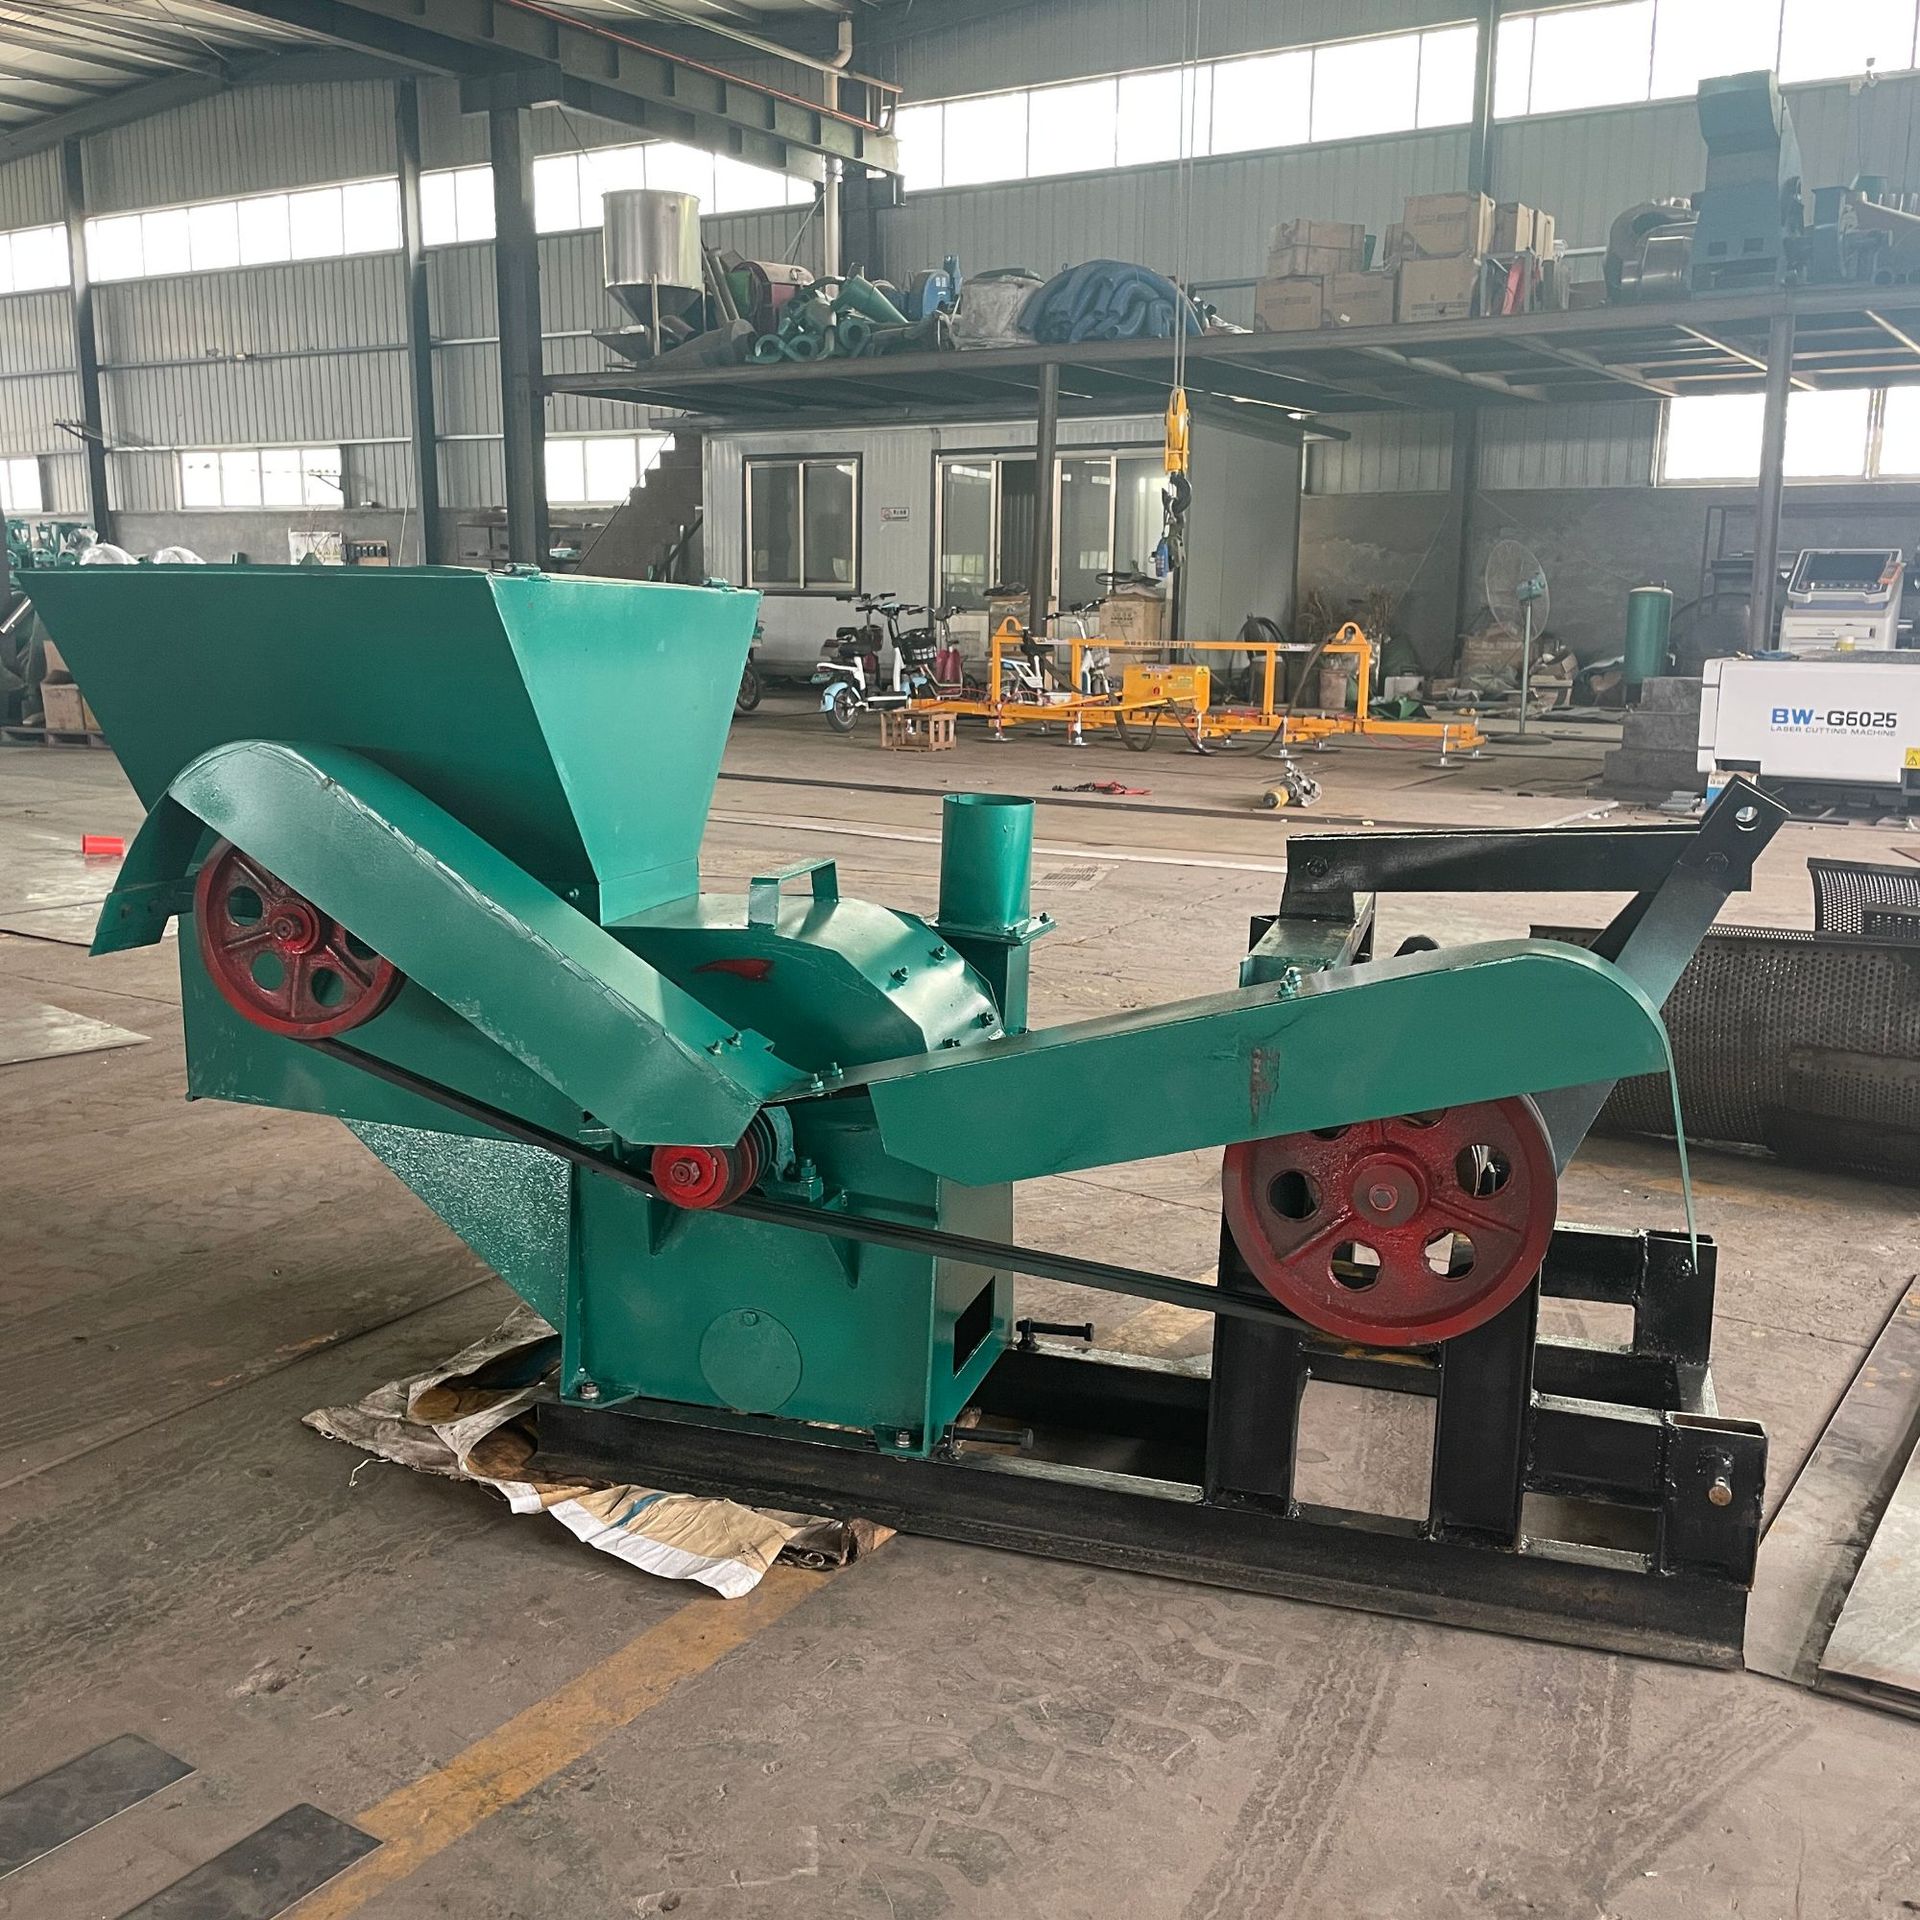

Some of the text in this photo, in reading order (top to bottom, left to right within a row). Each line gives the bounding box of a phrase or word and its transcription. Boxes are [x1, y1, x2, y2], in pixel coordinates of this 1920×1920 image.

[1771, 708, 1897, 728] BW-G6025
[1770, 725, 1897, 737] LASER CUTTING MACHINE
